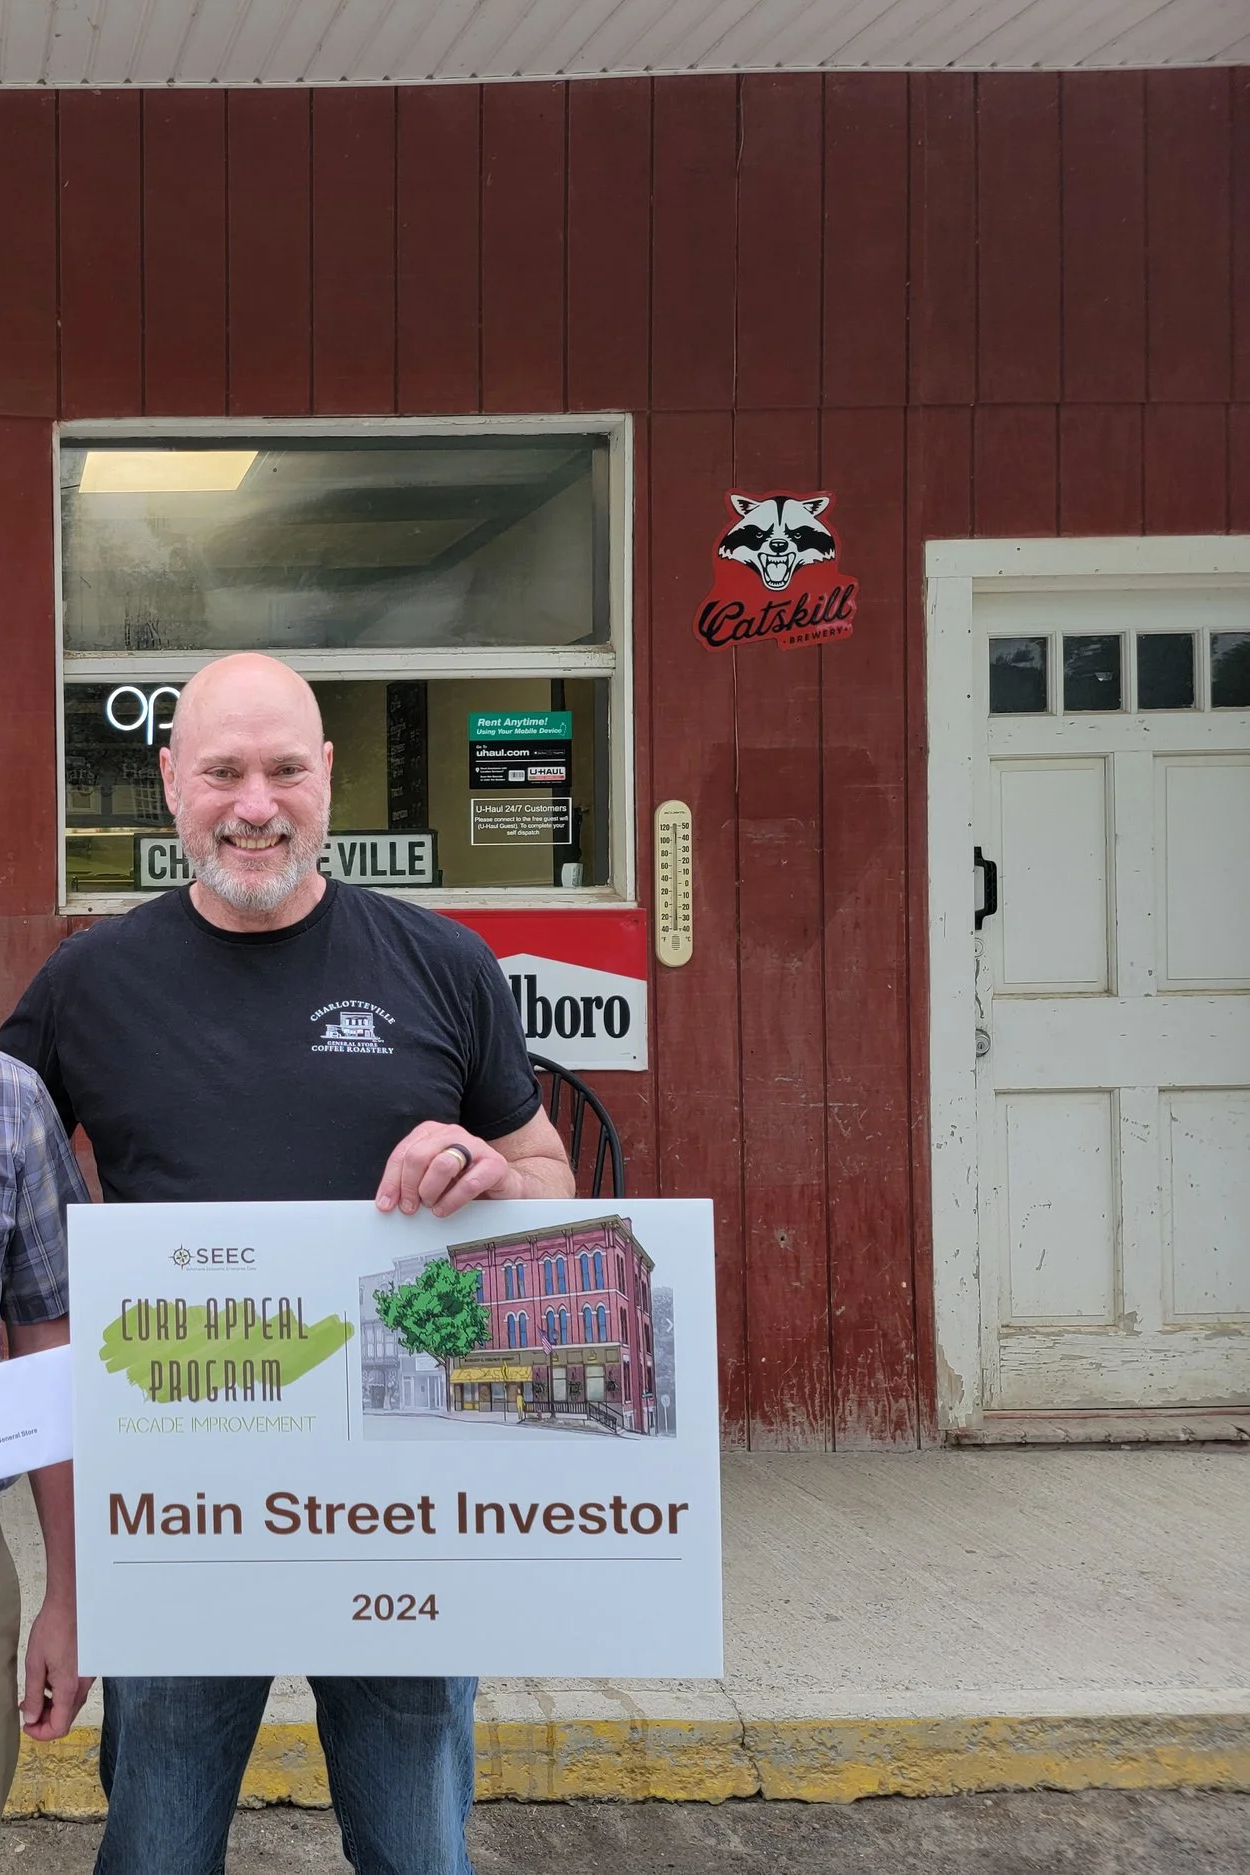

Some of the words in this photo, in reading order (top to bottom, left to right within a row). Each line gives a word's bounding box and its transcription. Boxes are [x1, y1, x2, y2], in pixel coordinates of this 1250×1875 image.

[699, 584, 855, 647] Catskill
[789, 627, 843, 644] BREWERY
[106, 686, 181, 745] op
[477, 718, 501, 727] Rent
[503, 717, 548, 728] Anytime!
[476, 728, 496, 736] Using
[476, 749, 530, 757] uhaul.com
[475, 805, 504, 813] U-Haul
[505, 805, 522, 813] 24/7
[524, 804, 567, 812] Customers
[147, 841, 426, 880] CHEVILLE
[310, 1000, 396, 1025] CHARLOTTEVILLE
[508, 974, 631, 1039] lboro
[346, 1046, 394, 1054] ROASTERY
[196, 1247, 255, 1264] SEEC
[121, 1298, 188, 1341] CURB
[204, 1297, 308, 1340] APPEAL
[149, 1359, 282, 1402] PROGRAM
[21, 1428, 38, 1438] Store
[118, 1417, 184, 1433] FACADE
[191, 1416, 316, 1432] IMPROVEMENT
[108, 1492, 243, 1535] Main
[264, 1491, 436, 1535] Street
[458, 1491, 689, 1535] Investor
[351, 1593, 439, 1621] 2024
